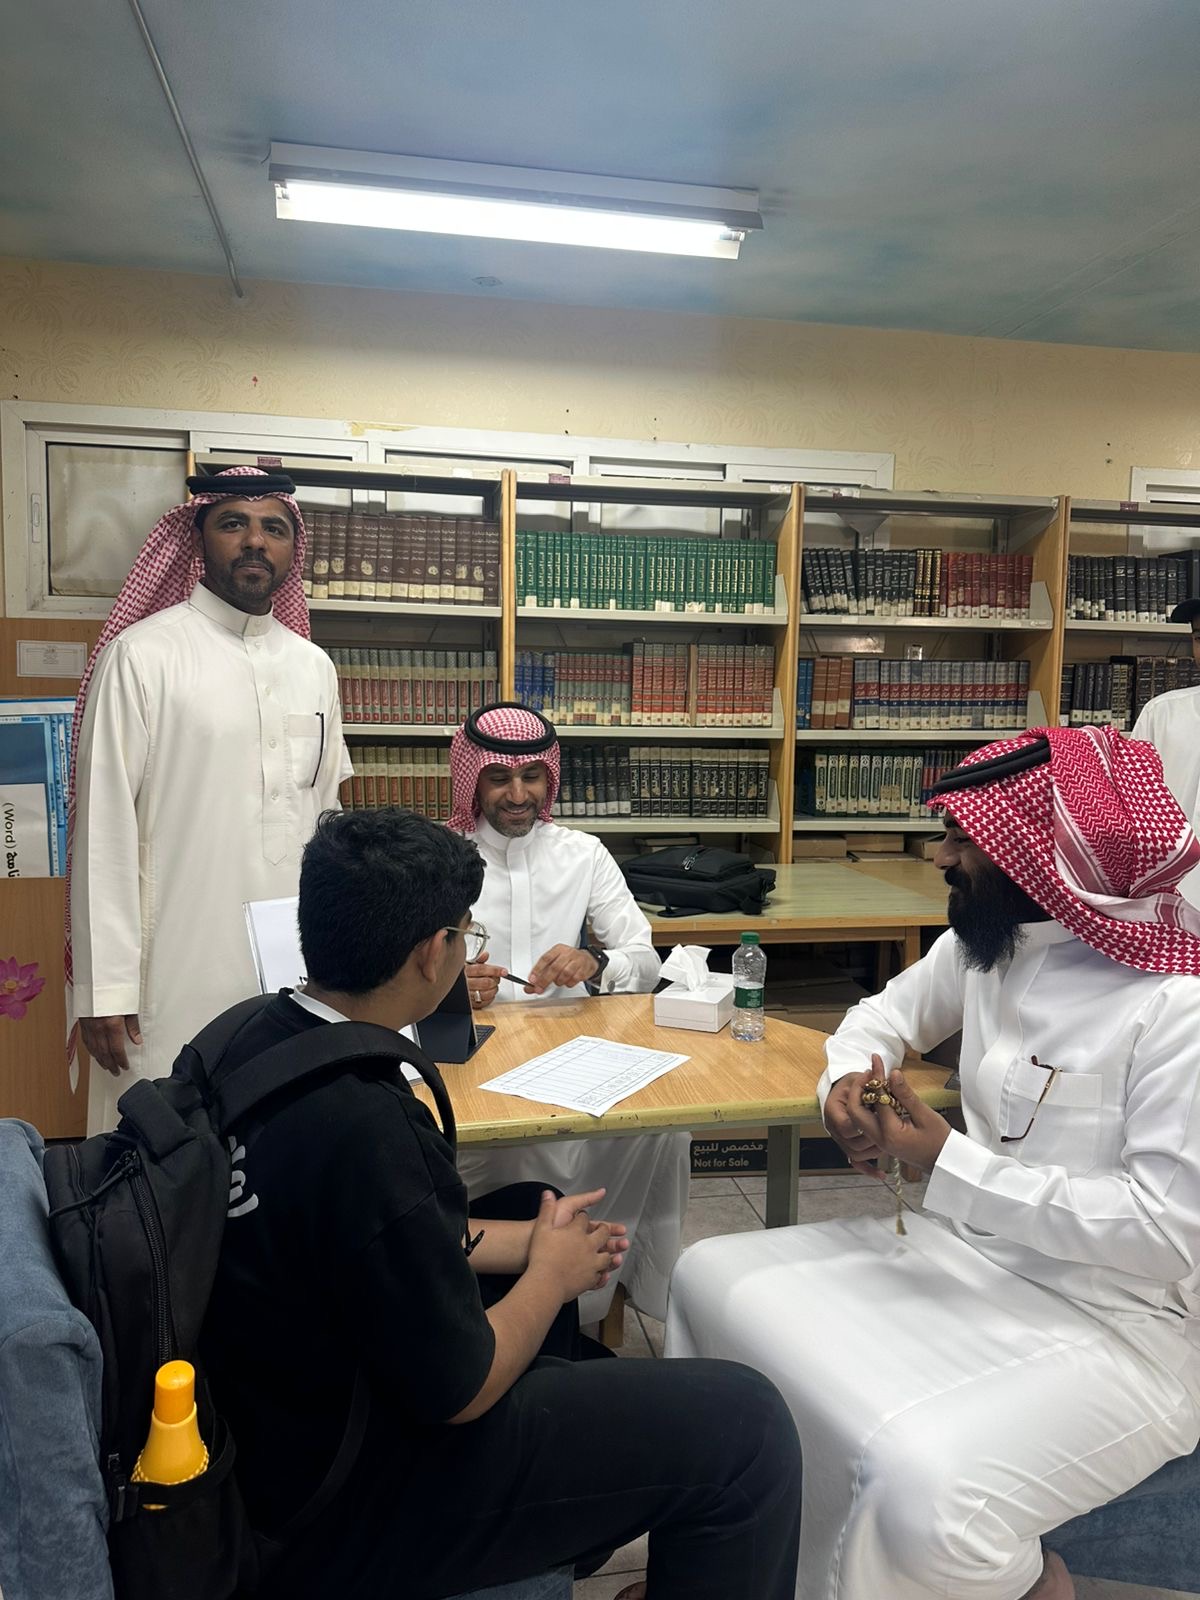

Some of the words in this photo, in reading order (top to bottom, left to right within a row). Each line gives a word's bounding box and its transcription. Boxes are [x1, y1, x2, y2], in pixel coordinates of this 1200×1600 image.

[693, 1143, 719, 1156] للبيع
[721, 1142, 763, 1153] مخصص
[694, 1159, 711, 1168] Not
[713, 1158, 726, 1167] for
[728, 1157, 749, 1167] Sale
